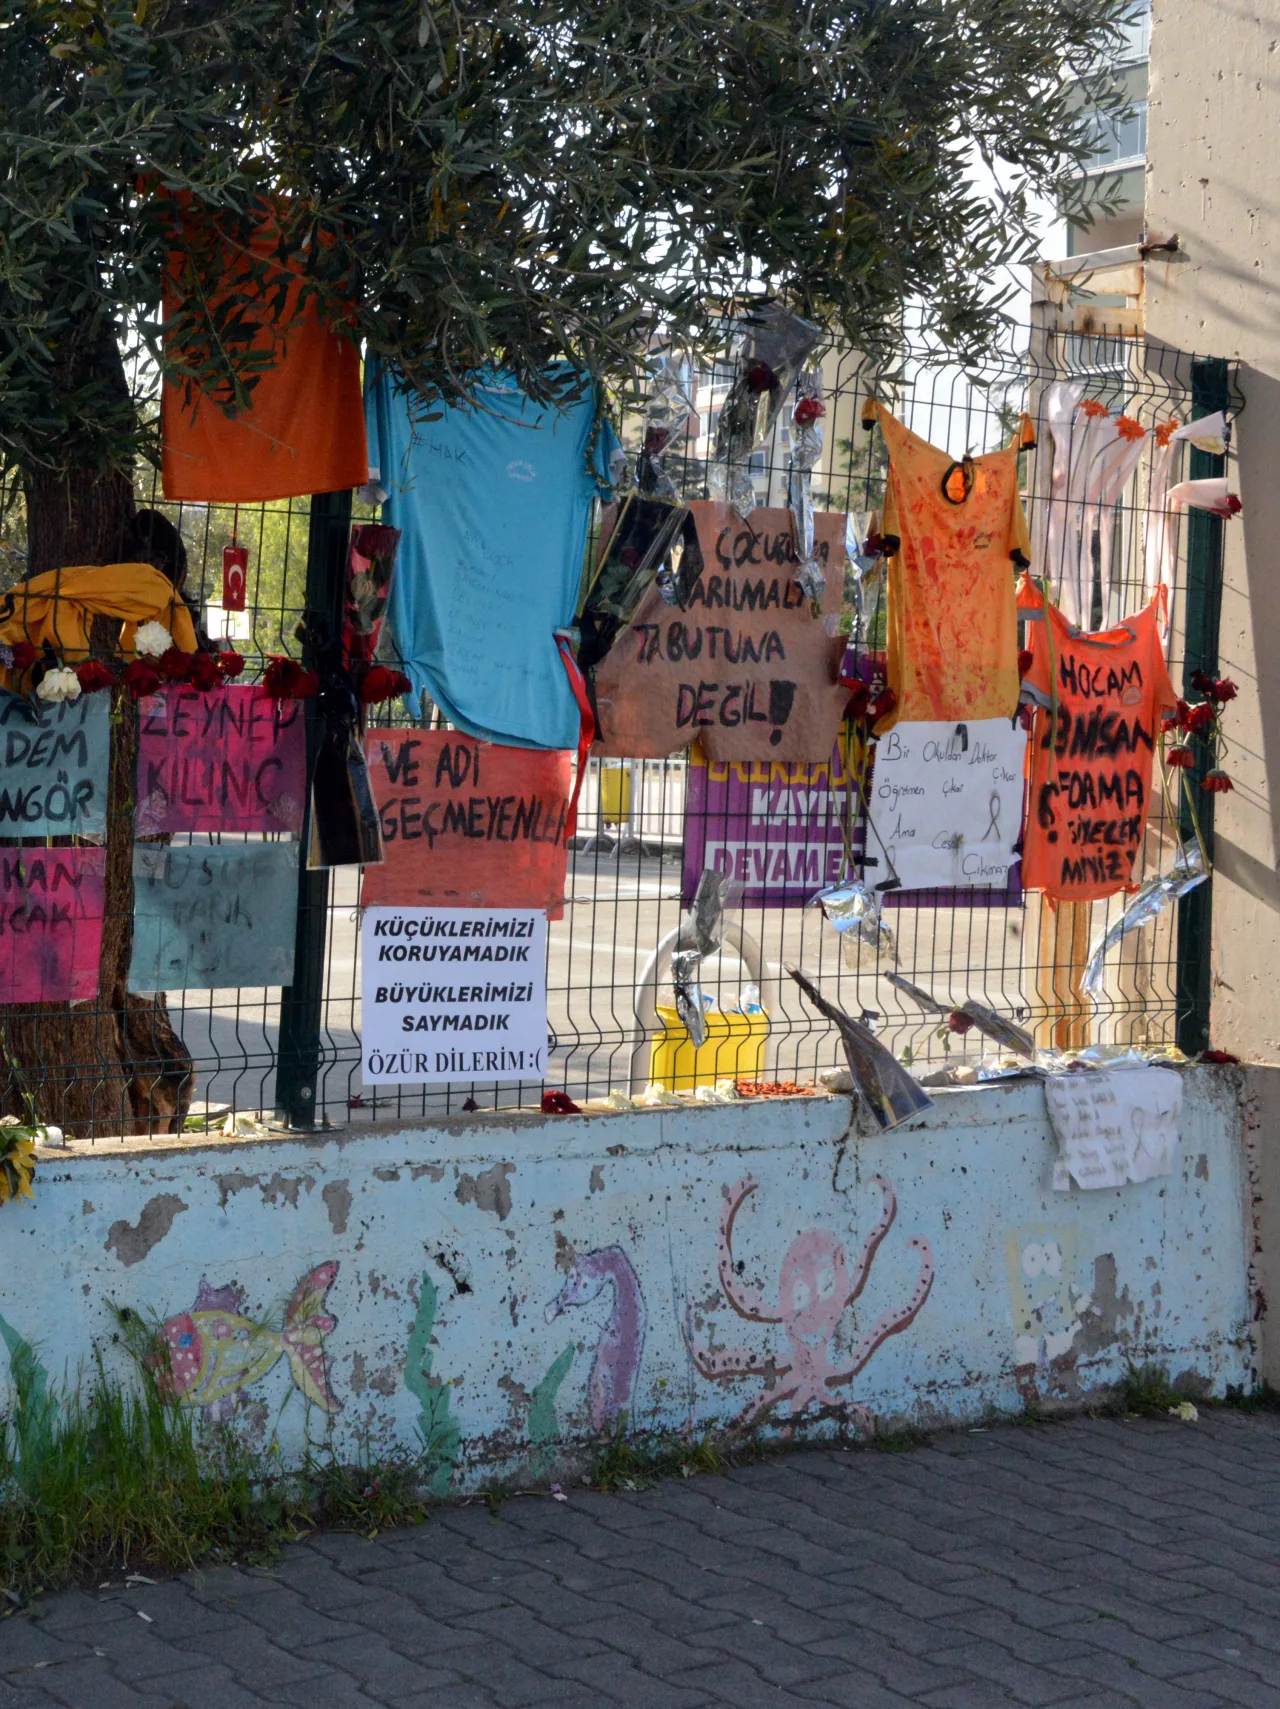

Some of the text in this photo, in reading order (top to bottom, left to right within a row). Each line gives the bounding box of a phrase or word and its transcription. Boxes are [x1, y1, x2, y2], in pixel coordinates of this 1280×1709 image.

[632, 620, 786, 665] TABUTUNA
[1060, 653, 1143, 699] HOCAM
[141, 691, 298, 744] ZEYNEP
[380, 739, 480, 789] VE ADI
[881, 732, 998, 765] Bir Okuldan Doktor
[1058, 768, 1145, 809] FORMA
[889, 813, 916, 840] Ama
[713, 848, 820, 883] DEVAM
[374, 916, 535, 942] KÜÇÜKLERİMİZİ
[379, 945, 530, 962] KORUYAMADIK
[375, 981, 534, 1004] BÜYÜKLERİMİZİ
[402, 1014, 510, 1032] SAYMADIK
[368, 1048, 429, 1075] ÖZÜR
[435, 1046, 524, 1073] DİLERİM
